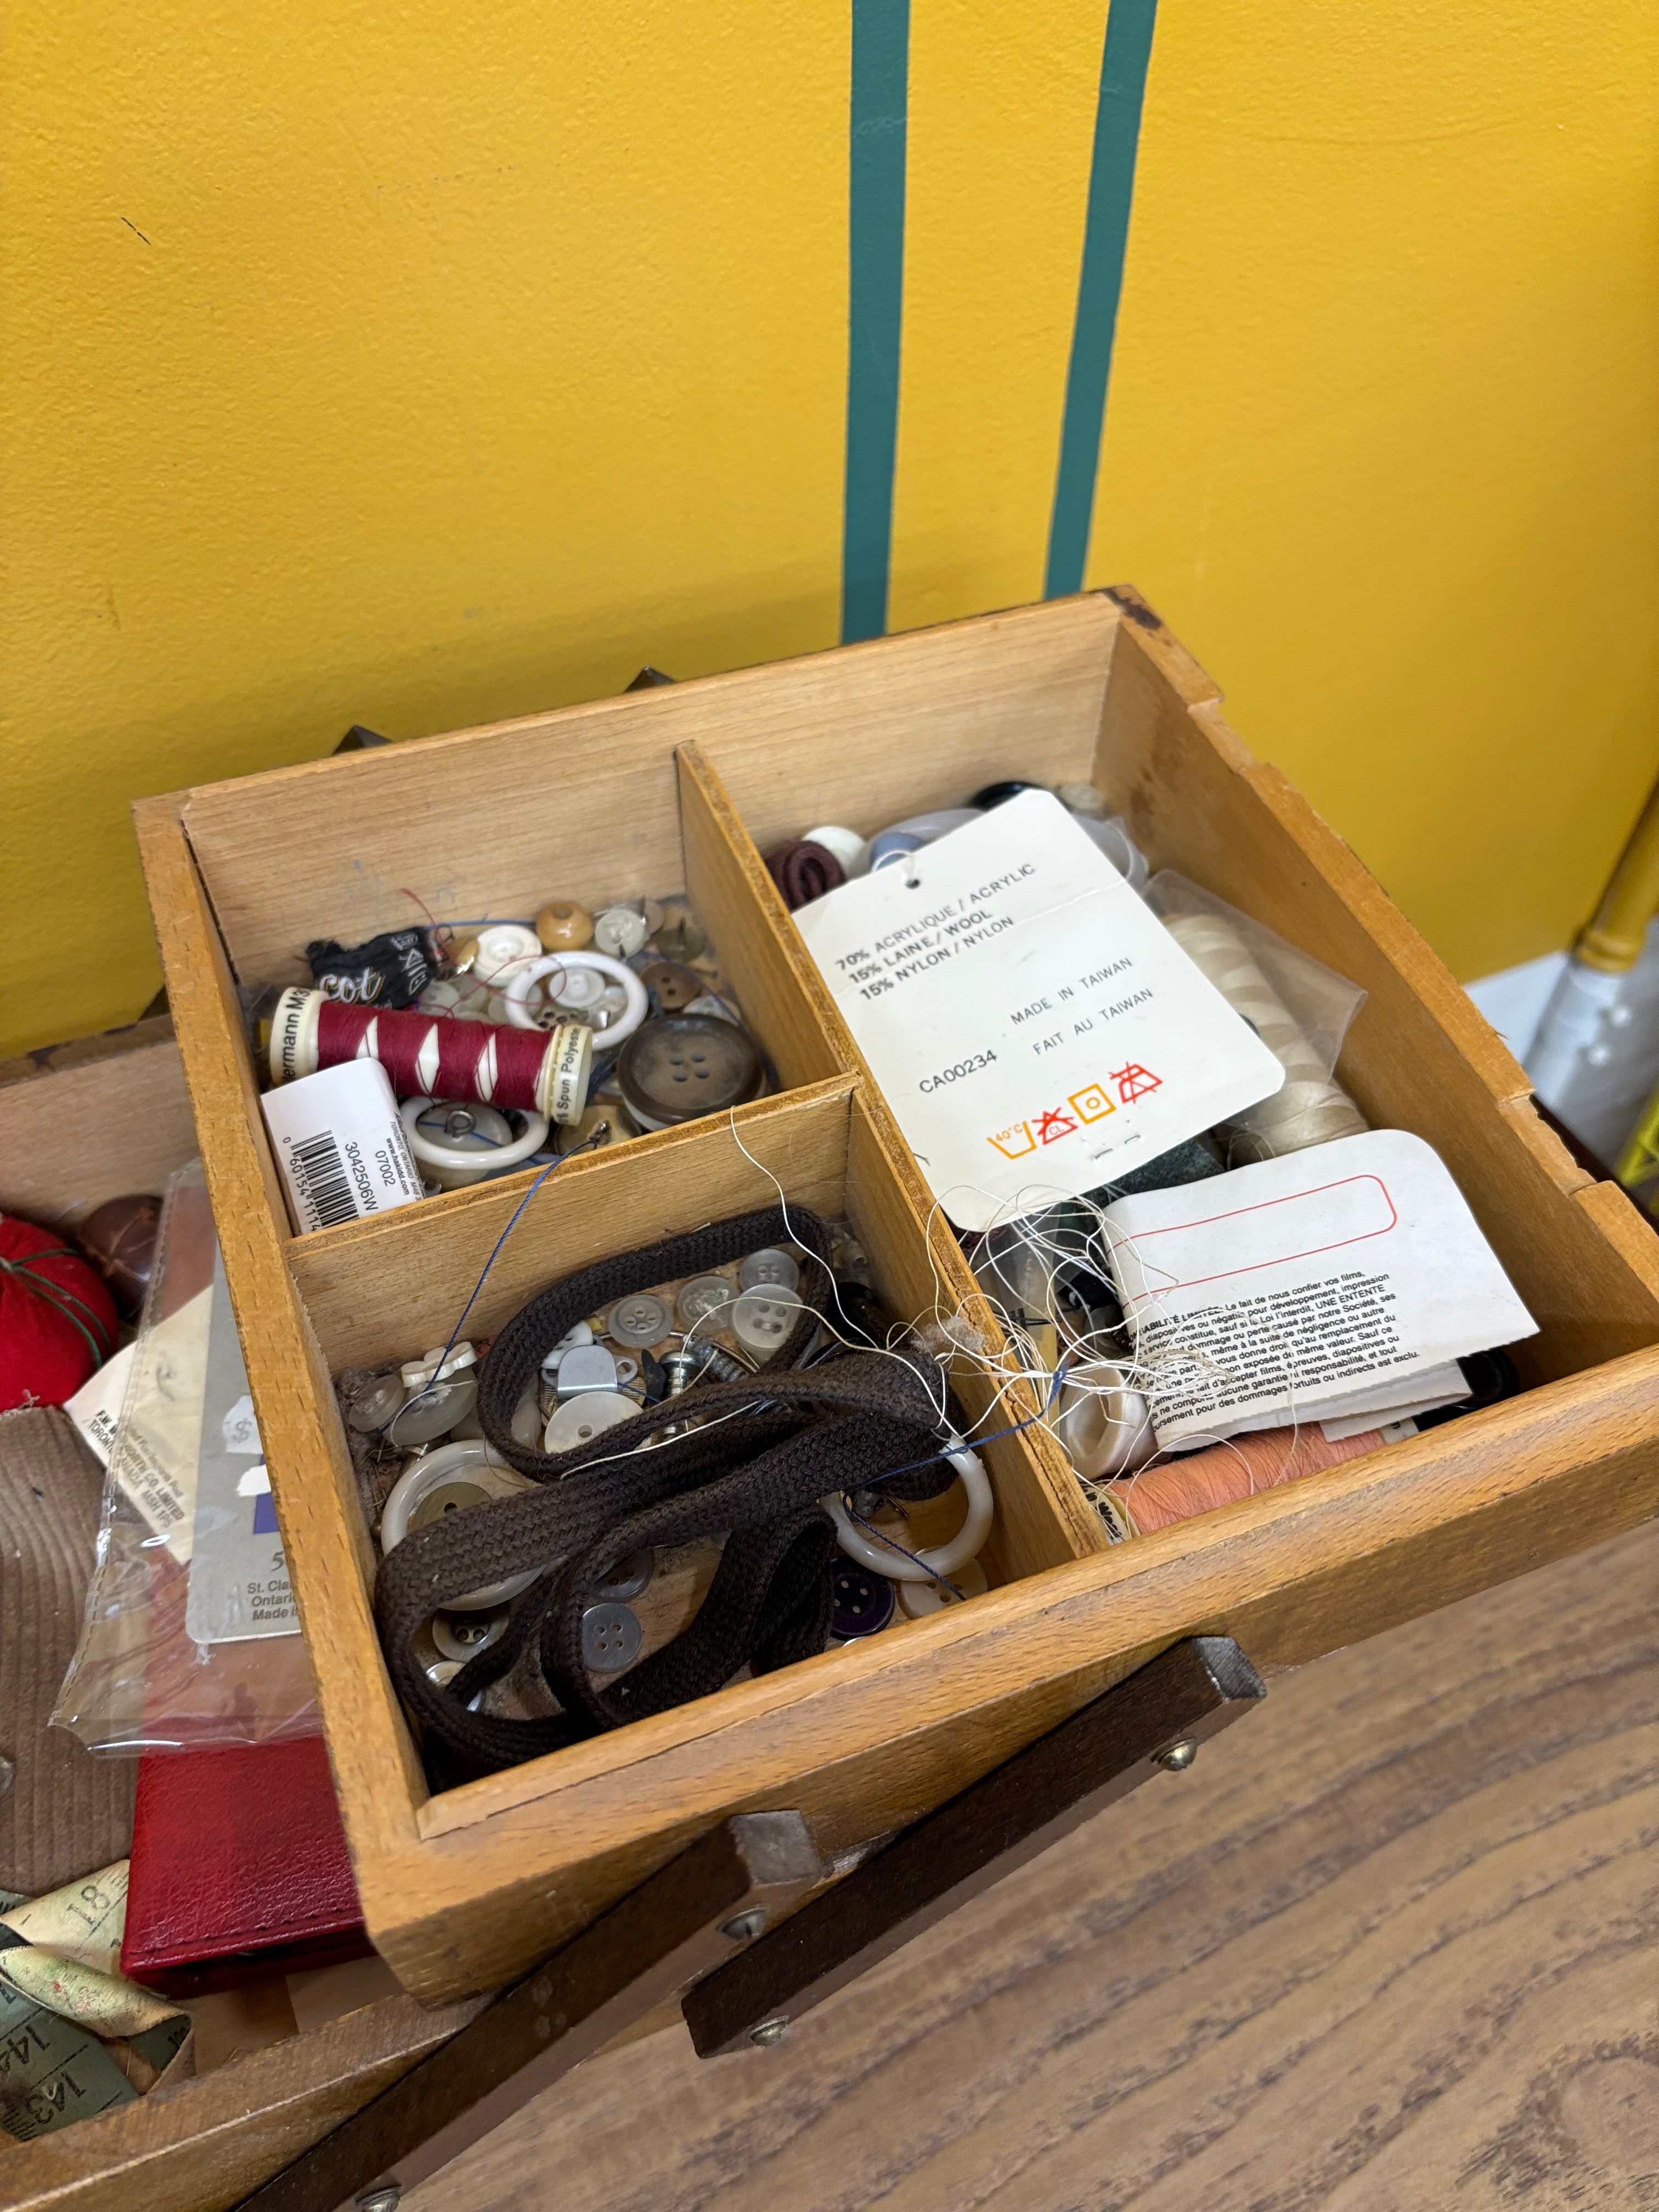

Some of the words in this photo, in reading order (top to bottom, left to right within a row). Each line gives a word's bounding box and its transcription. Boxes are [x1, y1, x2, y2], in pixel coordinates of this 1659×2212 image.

[835, 950, 870, 970] 70%
[875, 906, 956, 953] ACRYLIQUE
[969, 864, 1035, 904] ACRYLIC
[849, 963, 882, 983] 15%
[860, 978, 894, 1000] 15%
[895, 948, 951, 981] NYLON
[962, 916, 1014, 948] NYLON
[1011, 997, 1052, 1025] MADE
[1058, 986, 1074, 1001] IN
[1079, 957, 1133, 989] TAIWAN
[1032, 1031, 1063, 1055] FAIT
[1074, 1018, 1093, 1036] AU
[1099, 989, 1153, 1020] TAIWAN
[919, 1049, 997, 1093] CA00234
[556, 1080, 572, 1110] Spun
[288, 1156, 311, 1196] 60154
[345, 1142, 379, 1211] 3042506W
[375, 1150, 396, 1187] 07002
[386, 1137, 410, 1195] www.hakidd.com
[399, 1151, 414, 1180] ONTARIO
[1218, 1322, 1238, 1333] sauf
[1260, 1315, 1274, 1323] Loi
[1275, 1305, 1314, 1319] l'interdit,
[1315, 1297, 1338, 1309] UNE
[1338, 1284, 1386, 1303] ENTENTE
[1238, 1299, 1253, 1308] fait
[1268, 1291, 1290, 1301] nous
[1291, 1282, 1321, 1295] confier
[1323, 1278, 1340, 1286] vos
[1340, 1271, 1365, 1282] films,
[1247, 1306, 1267, 1318] pour
[1269, 1288, 1340, 1311] développement,
[1340, 1274, 1390, 1292] impression
[1210, 1344, 1238, 1356] même
[1259, 1334, 1281, 1344] suite
[1296, 1318, 1346, 1335] négligence
[1361, 1307, 1385, 1318] autre
[1246, 1327, 1270, 1339] perte
[1272, 1318, 1299, 1330] causé
[1301, 1314, 1316, 1325] par
[1318, 1308, 1341, 1319] notre
[1342, 1297, 1379, 1313] Société,
[1379, 1293, 1396, 1302] ses
[1179, 1364, 1200, 1375] part,
[1215, 1355, 1237, 1365] vous
[1239, 1347, 1267, 1359] donne
[1291, 1332, 1317, 1347] qu'au
[1318, 1318, 1383, 1340] remplacement
[1384, 1314, 1396, 1323] du
[1243, 1355, 1280, 1369] exposée
[1296, 1344, 1324, 1356] même
[1326, 1336, 1356, 1348] valeur.
[1357, 1328, 1379, 1340] Sauf
[1260, 1365, 1285, 1375] films,
[1332, 1339, 1386, 1358] diapositives
[1159, 1406, 1170, 1415] ne
[1251, 1374, 1288, 1390] garantie
[1301, 1354, 1367, 1376] responsabilité,
[1368, 1351, 1378, 1359] et
[1378, 1346, 1397, 1356] tout
[1195, 1403, 1216, 1416] pour
[1218, 1398, 1235, 1408] des
[1237, 1385, 1288, 1403] dommages
[1323, 1374, 1335, 1382] ou
[1336, 1363, 1376, 1378] indirects
[1377, 1358, 1392, 1367] est
[1393, 1351, 1420, 1363] exclu.
[247, 1582, 265, 1594] St.
[252, 1607, 289, 1621] Made
[66, 1884, 110, 1925] 18
